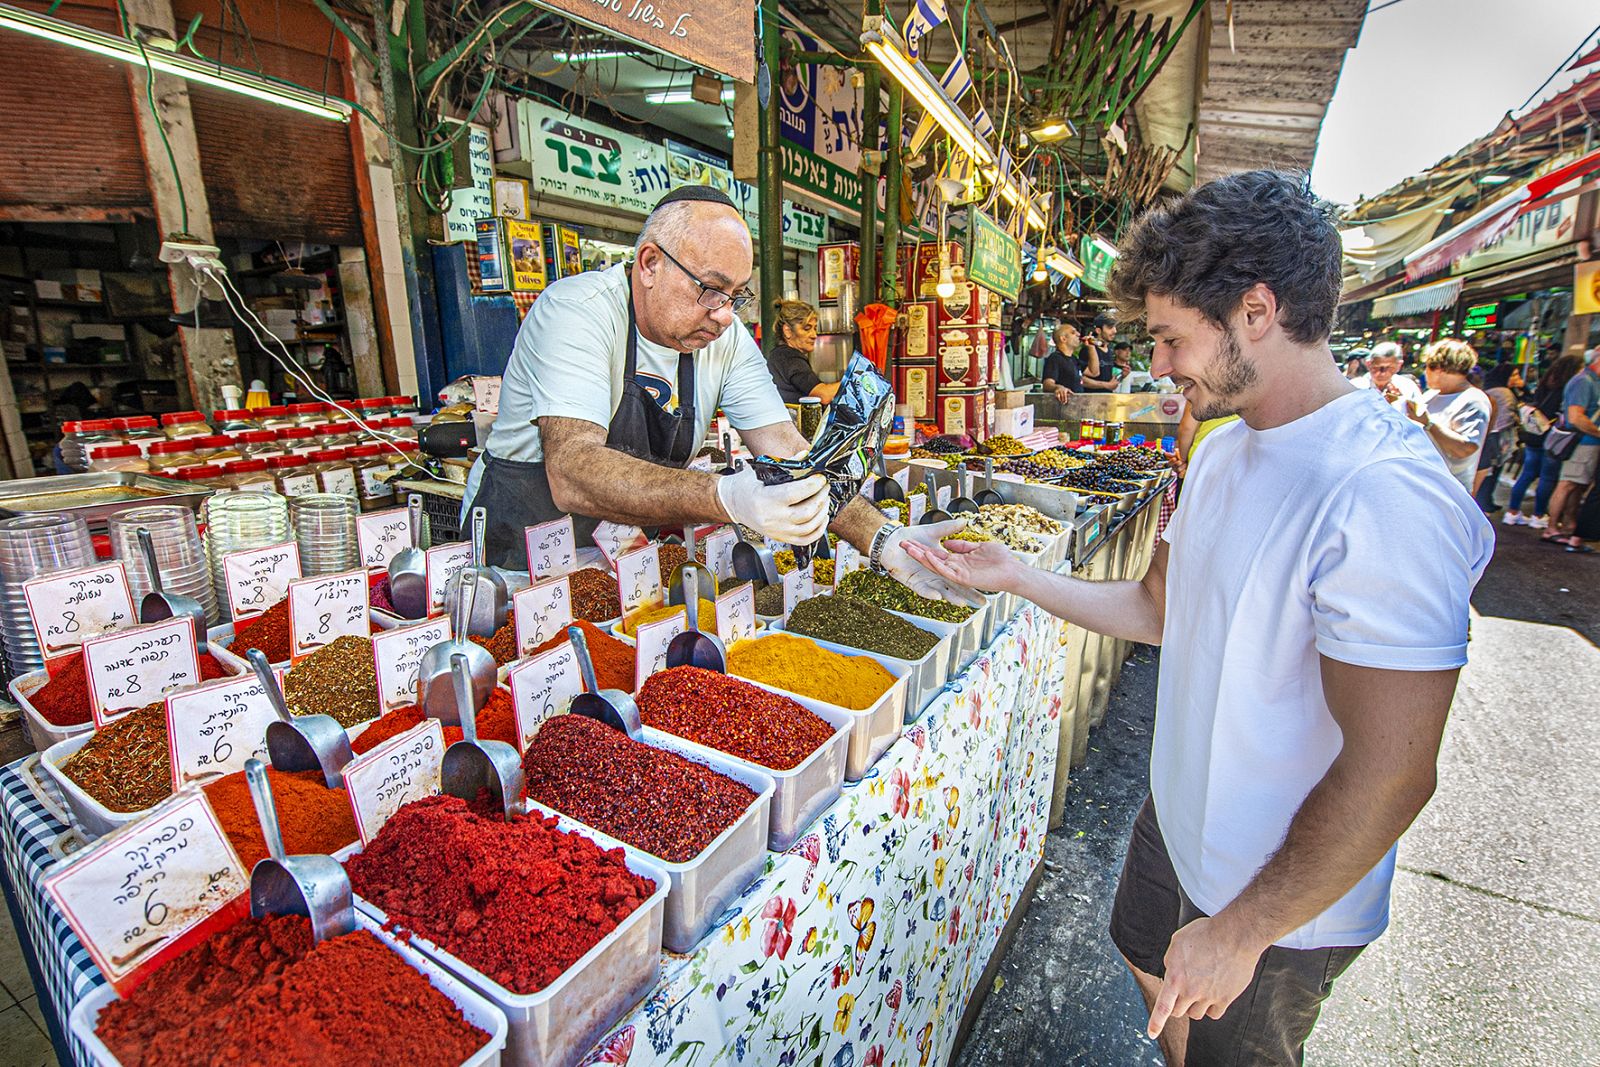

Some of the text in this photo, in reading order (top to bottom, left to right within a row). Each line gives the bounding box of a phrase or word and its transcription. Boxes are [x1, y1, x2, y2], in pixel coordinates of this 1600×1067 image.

[780, 107, 806, 134] תנובה
[473, 163, 492, 176] חציל
[545, 138, 622, 186] צבר
[781, 145, 828, 190] באיכו
[460, 207, 477, 218] פרוס
[449, 221, 468, 232] האש
[793, 212, 825, 239] צבר
[518, 275, 541, 285] Olives
[249, 553, 289, 567] תערובת
[374, 544, 385, 562] 8
[446, 551, 473, 564] ערובת
[544, 555, 552, 568] 8
[69, 573, 115, 592] פפריקה
[314, 578, 361, 591] תערובת
[634, 583, 642, 598] 6
[64, 589, 102, 605] מעושנת
[253, 586, 265, 603] 8
[62, 611, 80, 633] 8
[318, 612, 332, 634] 8
[406, 628, 442, 647] פפריקה
[535, 624, 544, 643] 6
[731, 624, 739, 641] 6
[128, 633, 181, 654] תערובת
[104, 650, 169, 673] תפוח אדמה
[126, 674, 142, 694] 8
[168, 672, 187, 681] 100
[543, 693, 555, 721] 6
[199, 721, 234, 737] חריפה
[213, 734, 233, 763] 6
[389, 735, 434, 766] פפריקה
[124, 817, 194, 862] פפריקה
[120, 837, 188, 890] מרוקאית
[207, 866, 230, 885] 100
[112, 871, 166, 905] חריפה
[144, 888, 168, 927] 6
